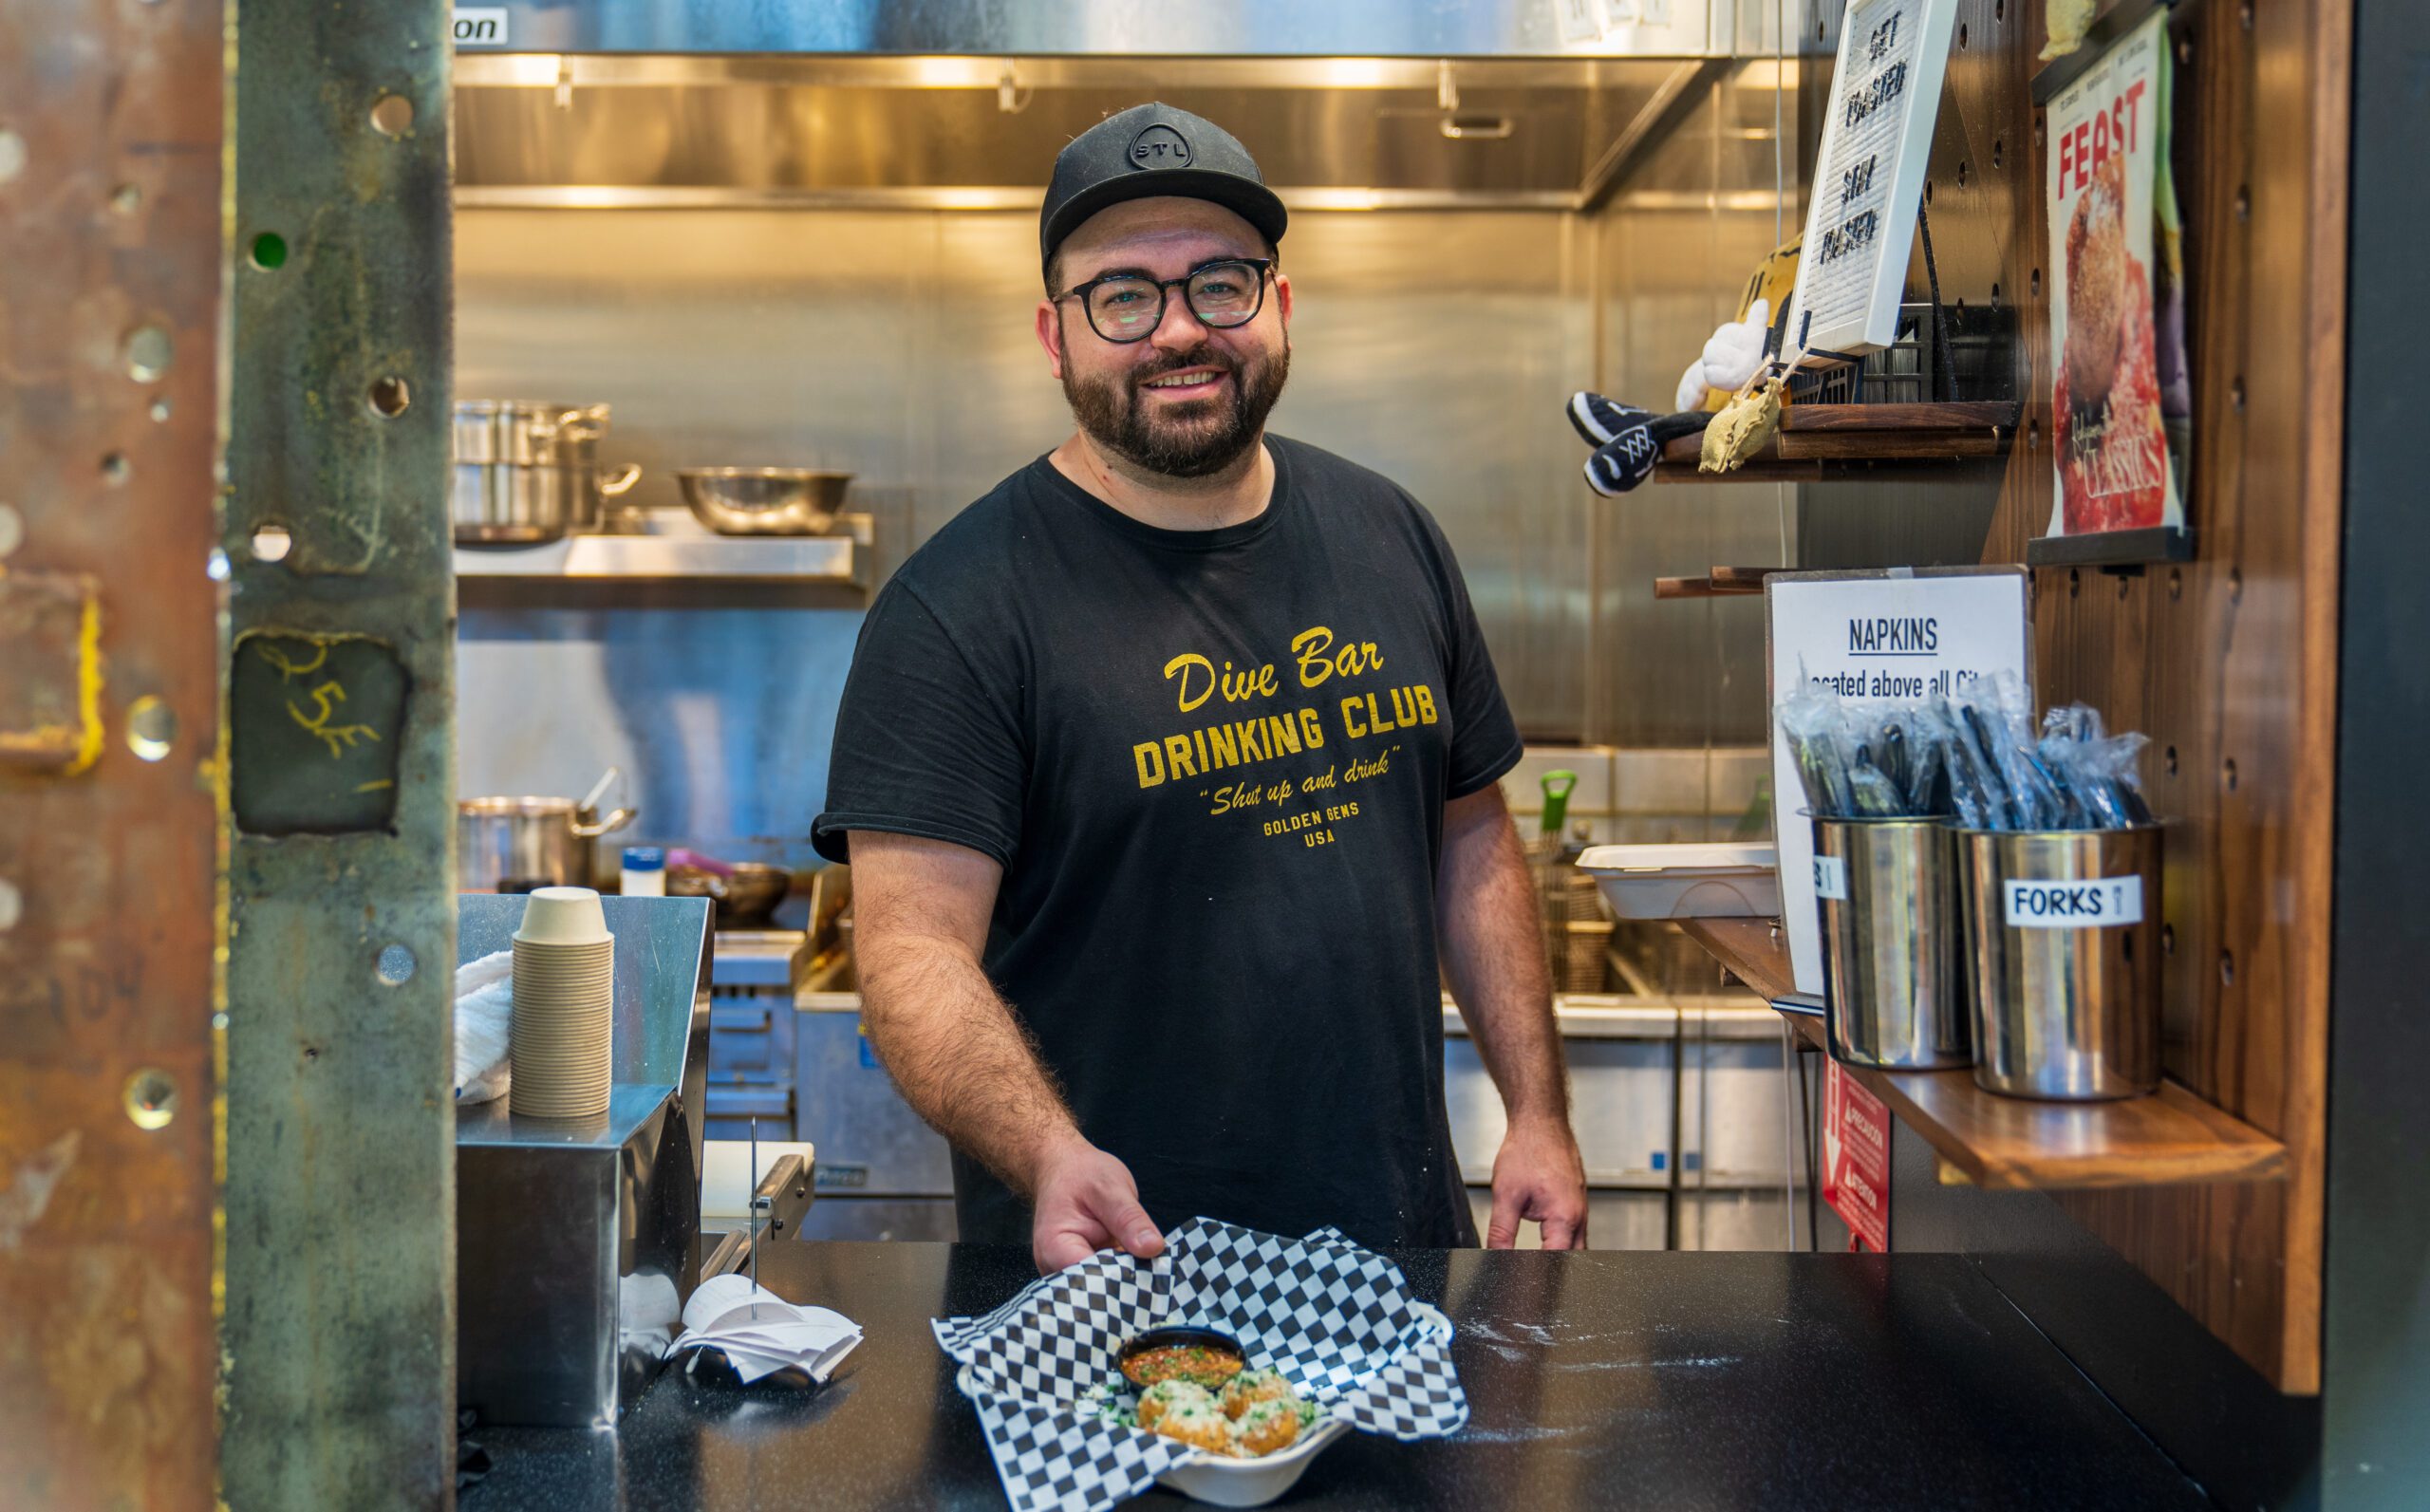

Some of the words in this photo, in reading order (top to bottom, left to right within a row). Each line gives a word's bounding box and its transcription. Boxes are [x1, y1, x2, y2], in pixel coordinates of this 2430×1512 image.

[1136, 142, 1187, 159] STL
[2058, 78, 2146, 202] FEAST
[1849, 617, 1938, 651] NAPKINS
[1164, 653, 1279, 713] Dive
[1291, 625, 1384, 688] Bar
[1872, 670, 1923, 698] above
[1930, 670, 1951, 698] all
[1132, 707, 1325, 790] DRINKING
[1340, 684, 1438, 739] CLUB
[1267, 782, 1293, 807] up
[1302, 765, 1336, 793] and
[1263, 810, 1322, 836] GOLDEN
[1326, 801, 1360, 822] GEMS
[1304, 829, 1336, 848] USA
[2014, 887, 2103, 916] FORKS
